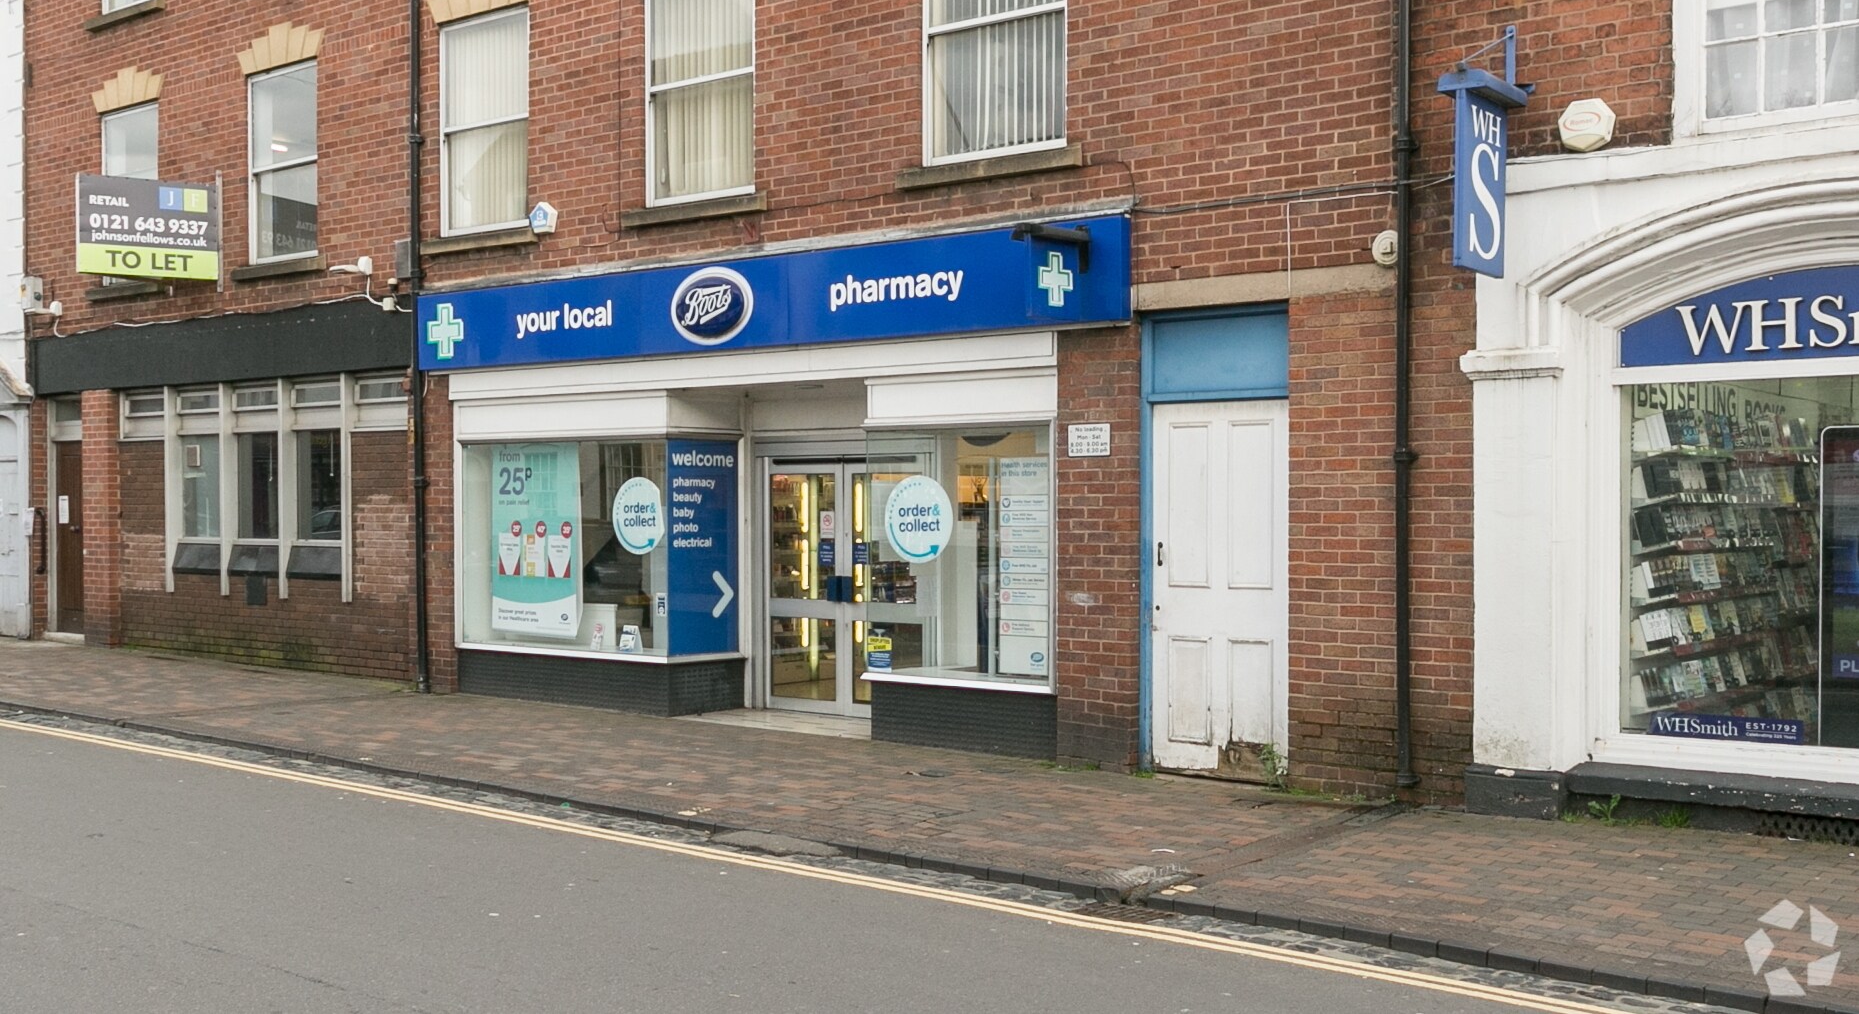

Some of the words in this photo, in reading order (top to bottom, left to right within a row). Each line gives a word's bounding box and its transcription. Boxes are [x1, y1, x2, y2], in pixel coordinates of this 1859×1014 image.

[1471, 104, 1501, 148] WH
[88, 194, 130, 207] RETAIL
[1469, 142, 1501, 260] S
[89, 213, 129, 230] 0121
[134, 217, 166, 233] 643
[169, 219, 208, 235] 9337
[91, 230, 207, 247] johnsonfellows.co.uk
[105, 249, 141, 269] TO
[151, 252, 193, 272] LET
[829, 269, 964, 312] pharmacy
[681, 283, 732, 326] Boots
[516, 309, 560, 340] your
[563, 299, 613, 330] local
[1675, 295, 1859, 356] WHS
[499, 450, 521, 463] from
[672, 450, 734, 467] welcome
[672, 476, 716, 489] pharmacy
[672, 492, 703, 504] beauty
[623, 515, 656, 527] collect
[672, 507, 695, 519] baby
[672, 522, 699, 534] photo
[898, 518, 941, 532] collect
[672, 537, 712, 548] electrical
[1656, 716, 1738, 737] WHSmith
